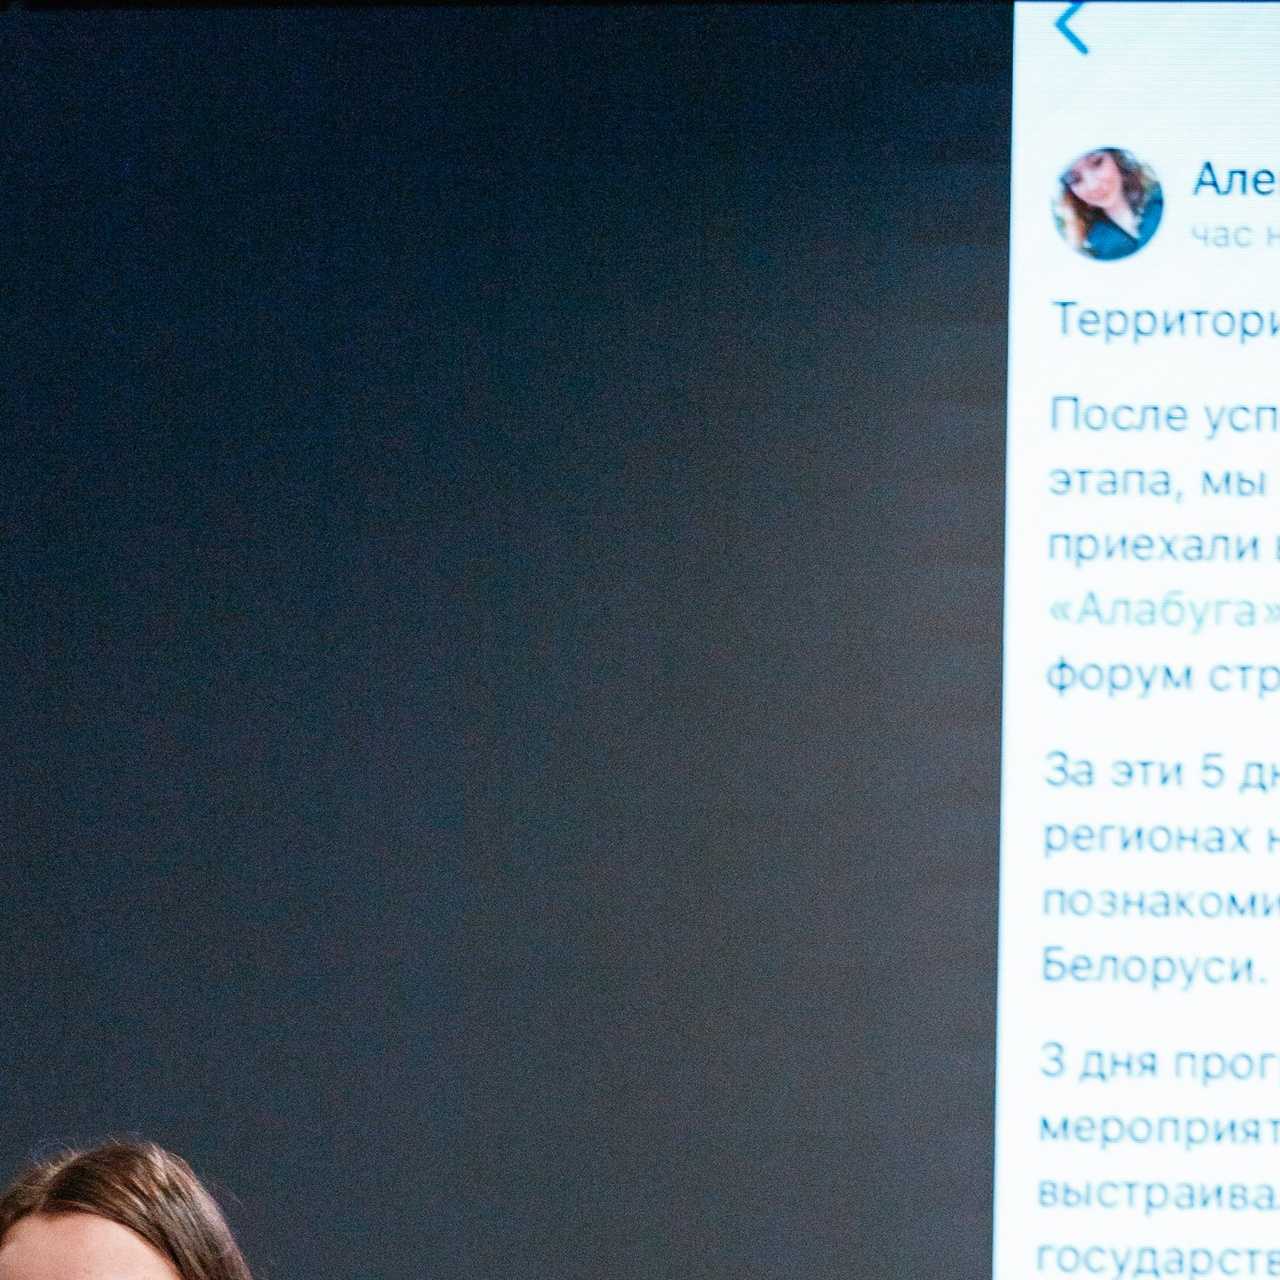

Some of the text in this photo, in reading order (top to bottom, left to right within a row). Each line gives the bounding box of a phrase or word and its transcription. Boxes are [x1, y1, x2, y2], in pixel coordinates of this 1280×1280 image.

[1191, 225, 1253, 249] час
[1050, 394, 1280, 441] После усп
[1049, 468, 1266, 503] этапа, мы
[1048, 532, 1260, 568] приехали
[1046, 655, 1193, 699] форум
[1045, 749, 1095, 788] За
[1112, 760, 1183, 787] эти
[1201, 752, 1226, 789] 5
[1044, 823, 1250, 858] регионах
[1042, 945, 1266, 991] Белоруси.
[1078, 1050, 1157, 1083] дня
[1038, 1180, 1280, 1217] выстраива
